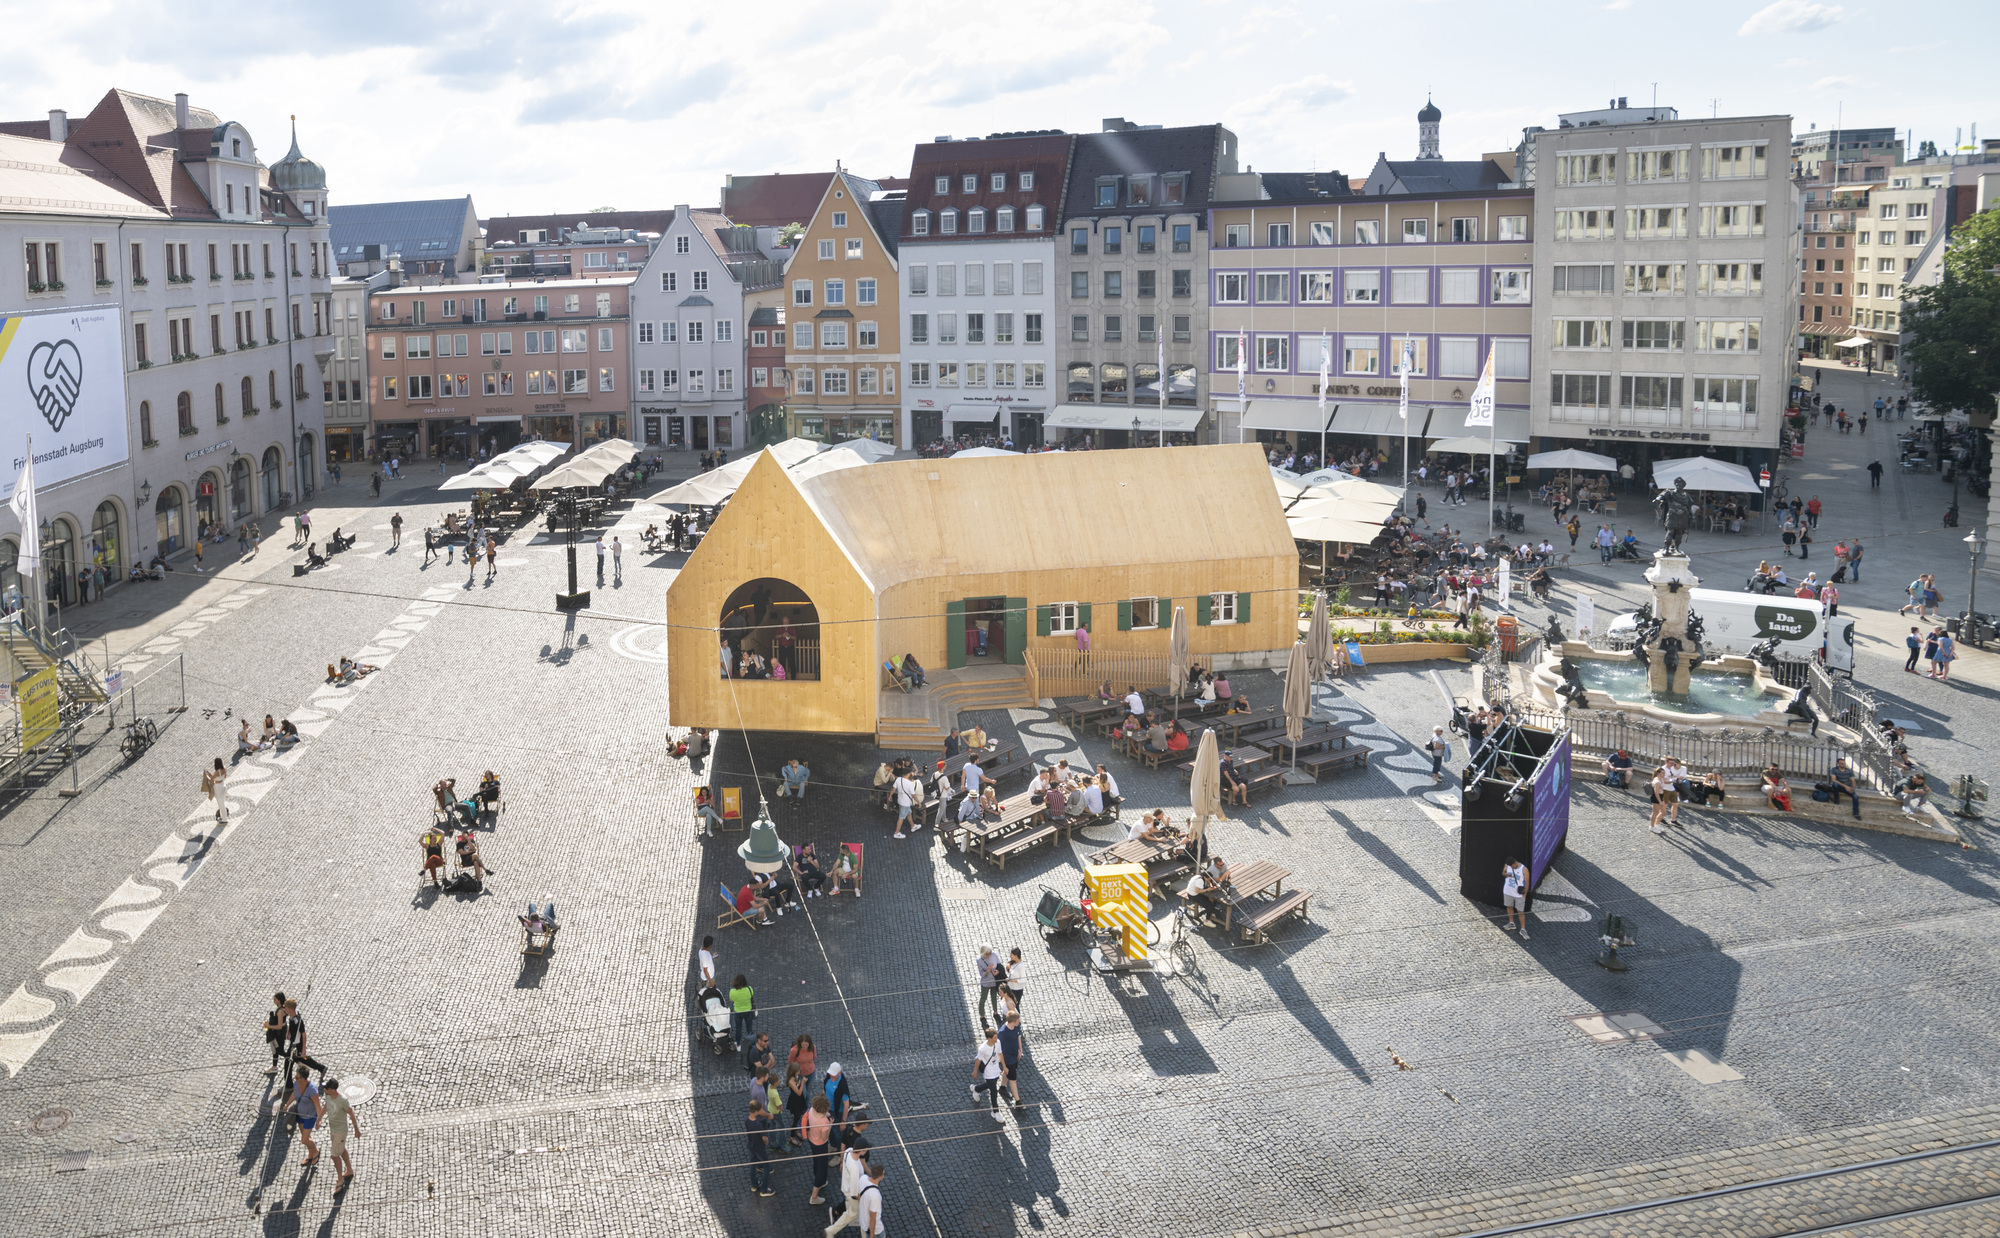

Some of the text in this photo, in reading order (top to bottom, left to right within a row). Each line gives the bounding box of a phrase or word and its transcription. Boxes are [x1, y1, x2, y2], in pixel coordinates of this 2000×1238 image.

[1312, 384, 1360, 395] HNRY'S
[1367, 386, 1410, 396] COFFE
[1589, 428, 1710, 440] HEYZEL COFFEE
[70, 436, 104, 454] Augsburg
[1776, 612, 1795, 623] Da
[1769, 622, 1802, 634] lang!
[22, 678, 55, 702] CUSTOVIC
[1101, 880, 1121, 888] next
[1101, 888, 1121, 898] 500
